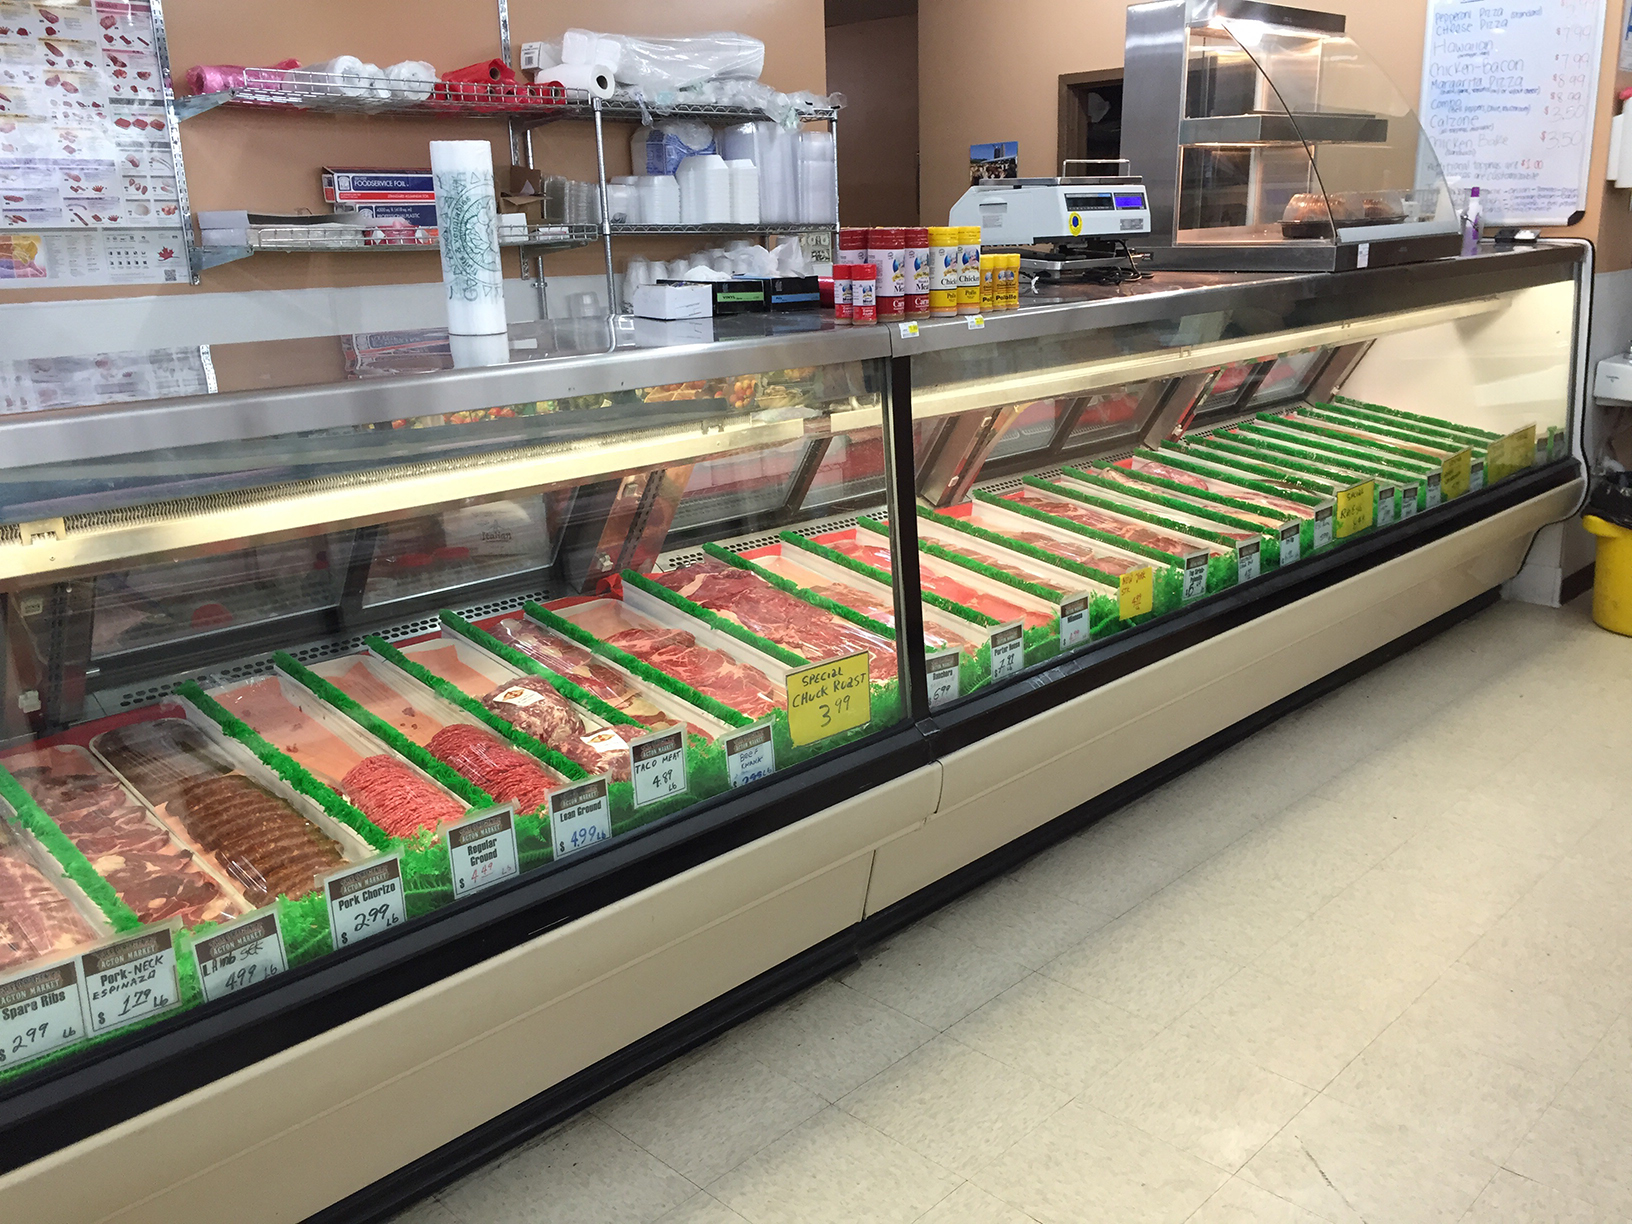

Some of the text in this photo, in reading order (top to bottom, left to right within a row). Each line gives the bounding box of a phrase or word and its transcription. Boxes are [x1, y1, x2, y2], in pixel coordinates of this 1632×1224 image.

[354, 179, 406, 188] FOODSERVICE FOIL
[635, 750, 682, 774] TACO MEAT
[560, 800, 602, 823] Lean Ground
[467, 838, 498, 856] Regular
[470, 849, 498, 867] Ground
[559, 840, 566, 853] $
[458, 877, 466, 889] $
[338, 882, 396, 911] Pork Chorizo
[212, 942, 235, 956] ACTON
[237, 929, 262, 945] MARKET
[341, 931, 348, 945] $
[101, 954, 125, 969] ACTON
[127, 944, 156, 959] MARKET
[1, 990, 27, 1005] ACTON
[29, 978, 60, 995] MARKET
[92, 969, 156, 1001] ESPINAZO
[1, 991, 66, 1021] Spare Ribs
[97, 1011, 106, 1025] $
